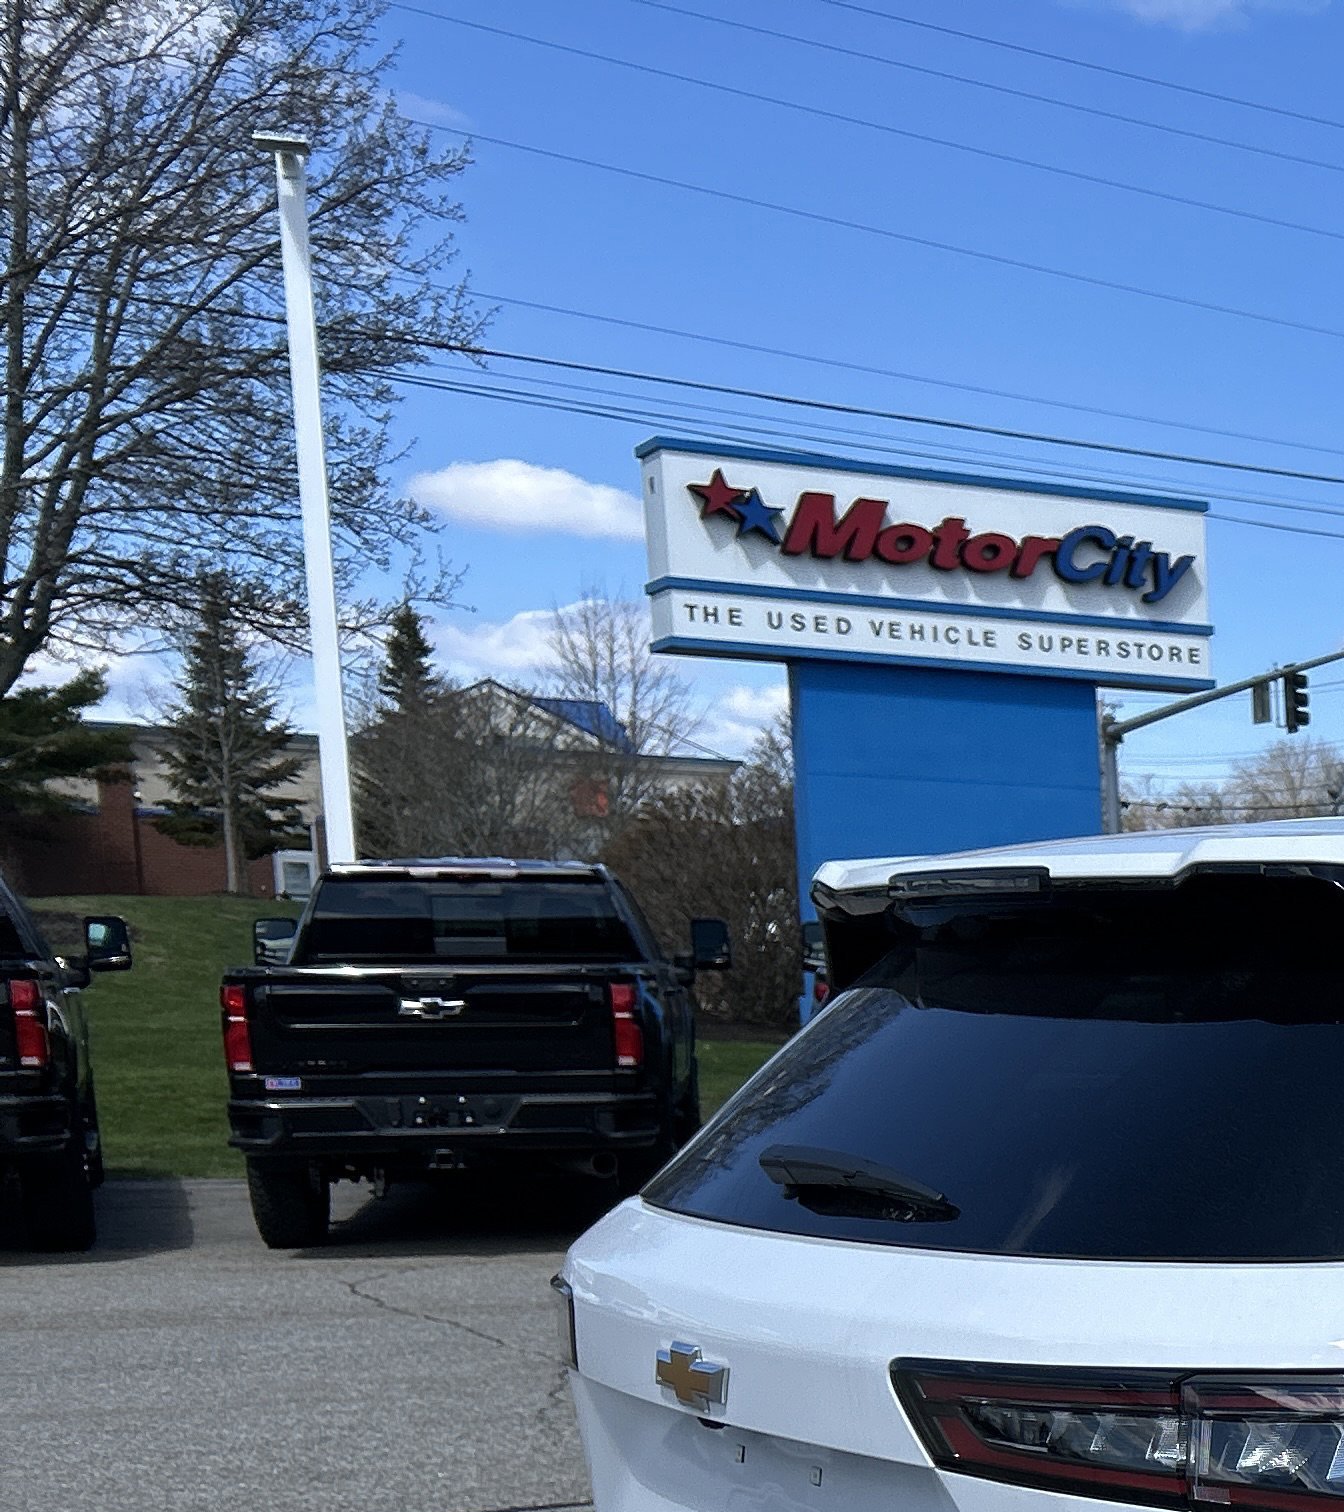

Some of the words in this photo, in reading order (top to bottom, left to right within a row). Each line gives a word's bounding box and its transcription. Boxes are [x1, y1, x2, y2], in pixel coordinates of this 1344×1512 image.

[784, 492, 1196, 602] MotorCity
[684, 603, 744, 628] THE
[767, 610, 852, 638] USED
[870, 619, 998, 650] VEHICLE
[1017, 631, 1202, 666] SUPERSTORE
